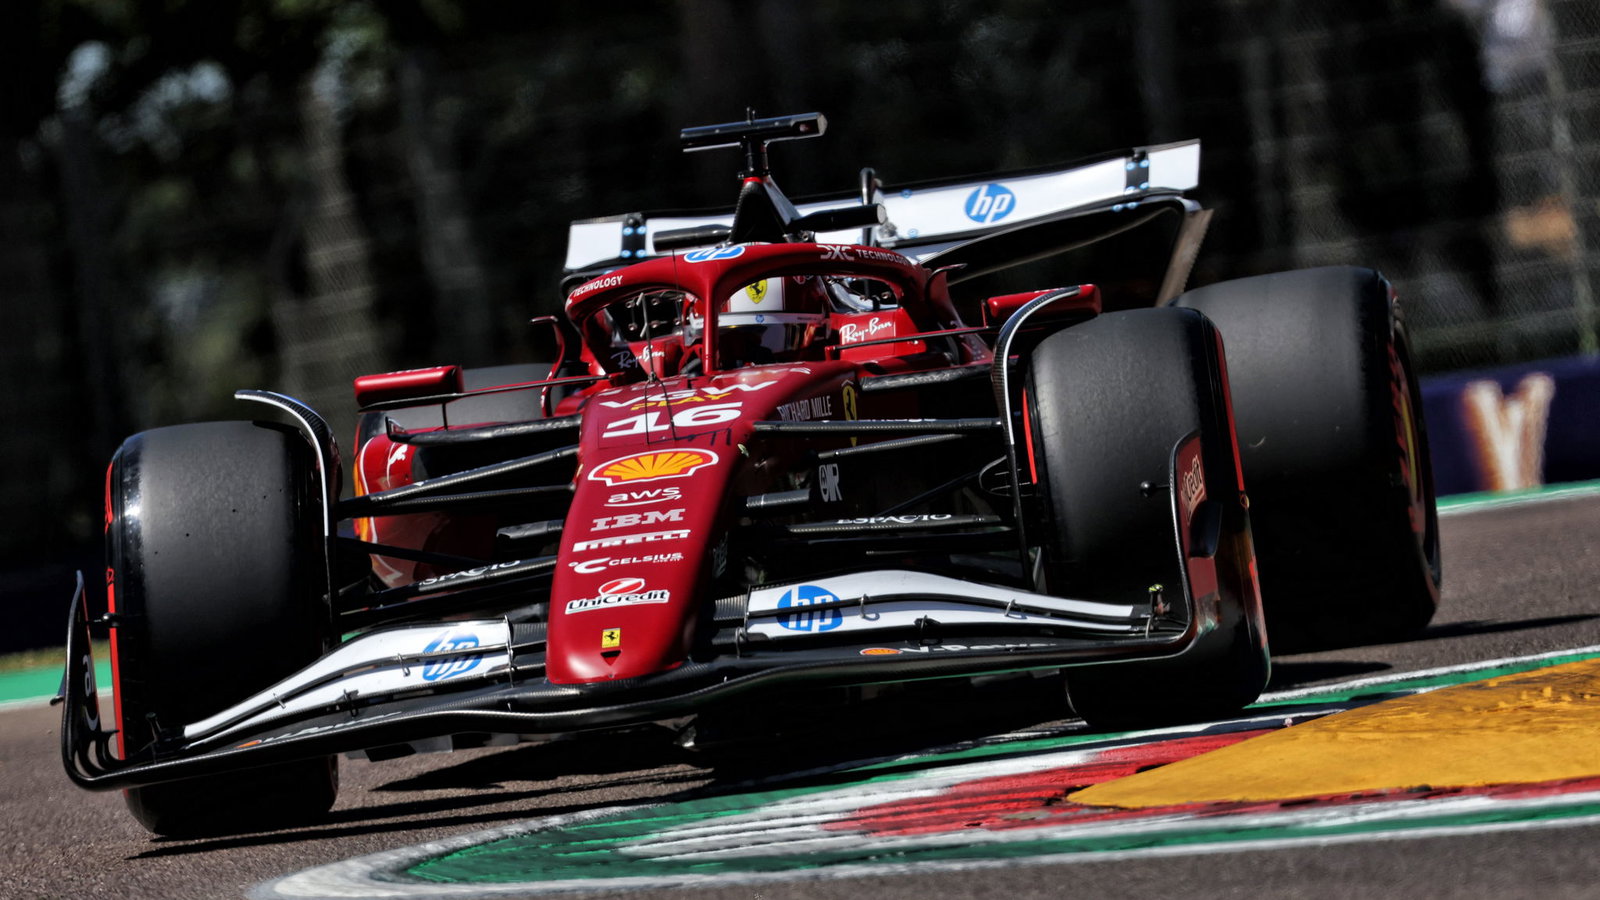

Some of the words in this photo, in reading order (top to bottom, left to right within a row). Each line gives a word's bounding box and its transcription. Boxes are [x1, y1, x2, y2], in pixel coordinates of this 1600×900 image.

[968, 184, 1013, 224] hp
[816, 244, 855, 261] DXC
[572, 275, 623, 298] TECHNOLOGY
[839, 317, 893, 345] Ray-Ban
[599, 380, 778, 408] VGW
[602, 402, 743, 438] 16
[606, 486, 682, 505] aws
[590, 508, 686, 532] IBM
[608, 553, 683, 566] CELSIUS
[568, 590, 667, 610] UniCredit
[785, 585, 837, 632] hp
[425, 631, 478, 681] hp
